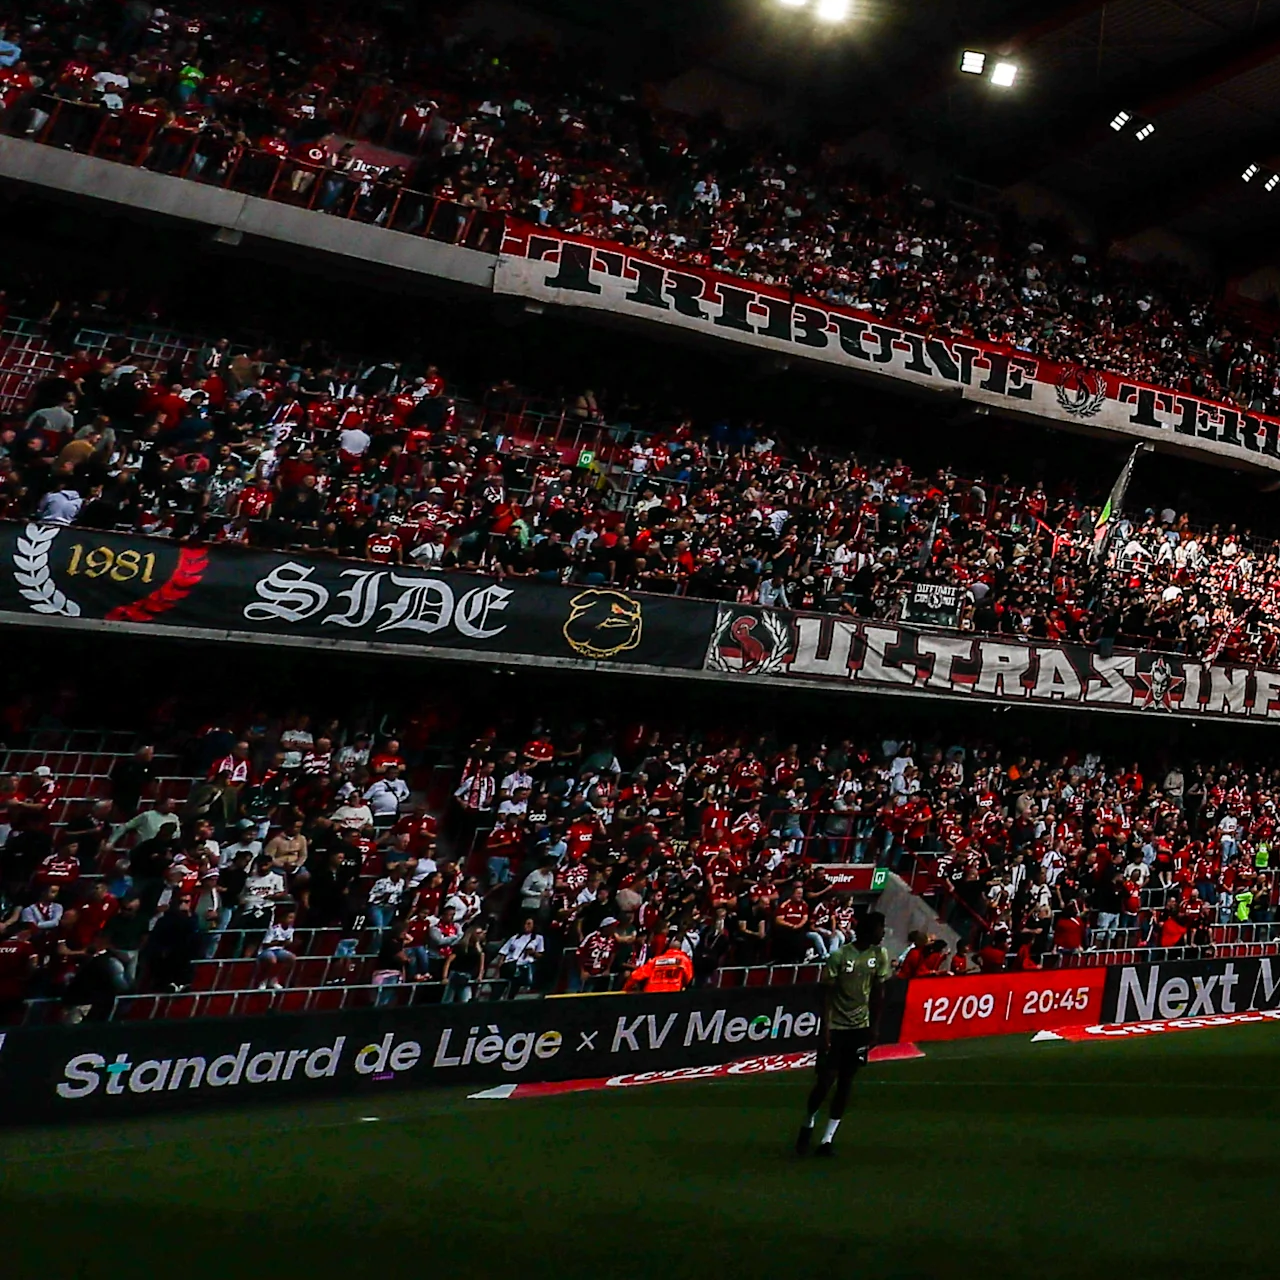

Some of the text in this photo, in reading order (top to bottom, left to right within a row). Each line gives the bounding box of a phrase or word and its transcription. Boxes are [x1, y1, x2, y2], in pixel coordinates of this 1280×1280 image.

[527, 234, 1038, 401] TRIBUNE
[66, 543, 156, 584] 1981
[243, 560, 515, 639] SIDE
[787, 617, 1136, 704] ULTRAS
[923, 992, 994, 1024] 12/09
[1023, 987, 1089, 1014] 20:45
[1115, 963, 1239, 1023] Next
[56, 1035, 347, 1099] Standard
[353, 1032, 422, 1076] de
[433, 1023, 563, 1072] Liège
[610, 1012, 679, 1053] KV
